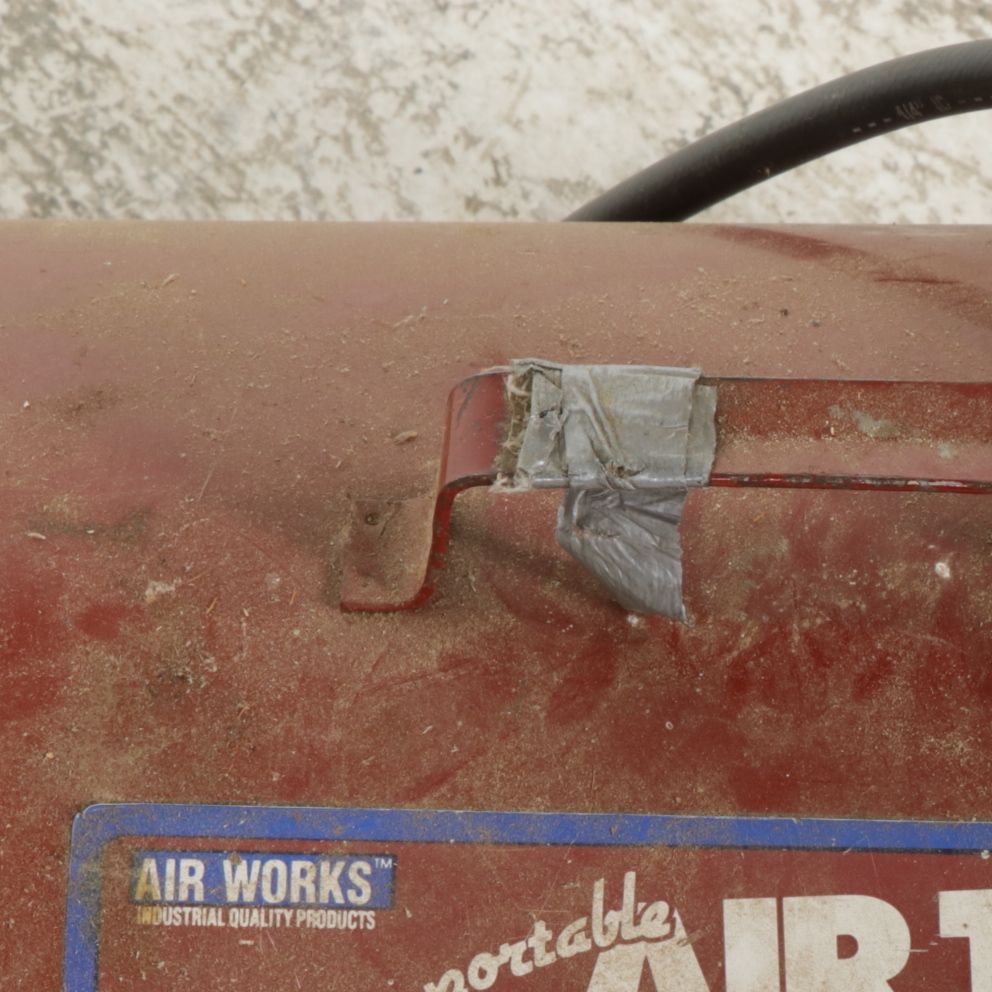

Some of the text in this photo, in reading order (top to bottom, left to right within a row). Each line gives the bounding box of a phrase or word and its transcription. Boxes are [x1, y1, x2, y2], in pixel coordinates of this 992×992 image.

[135, 858, 205, 903] AIR
[137, 906, 376, 931] INDUSTRIAL QUALITY PRODUCTS
